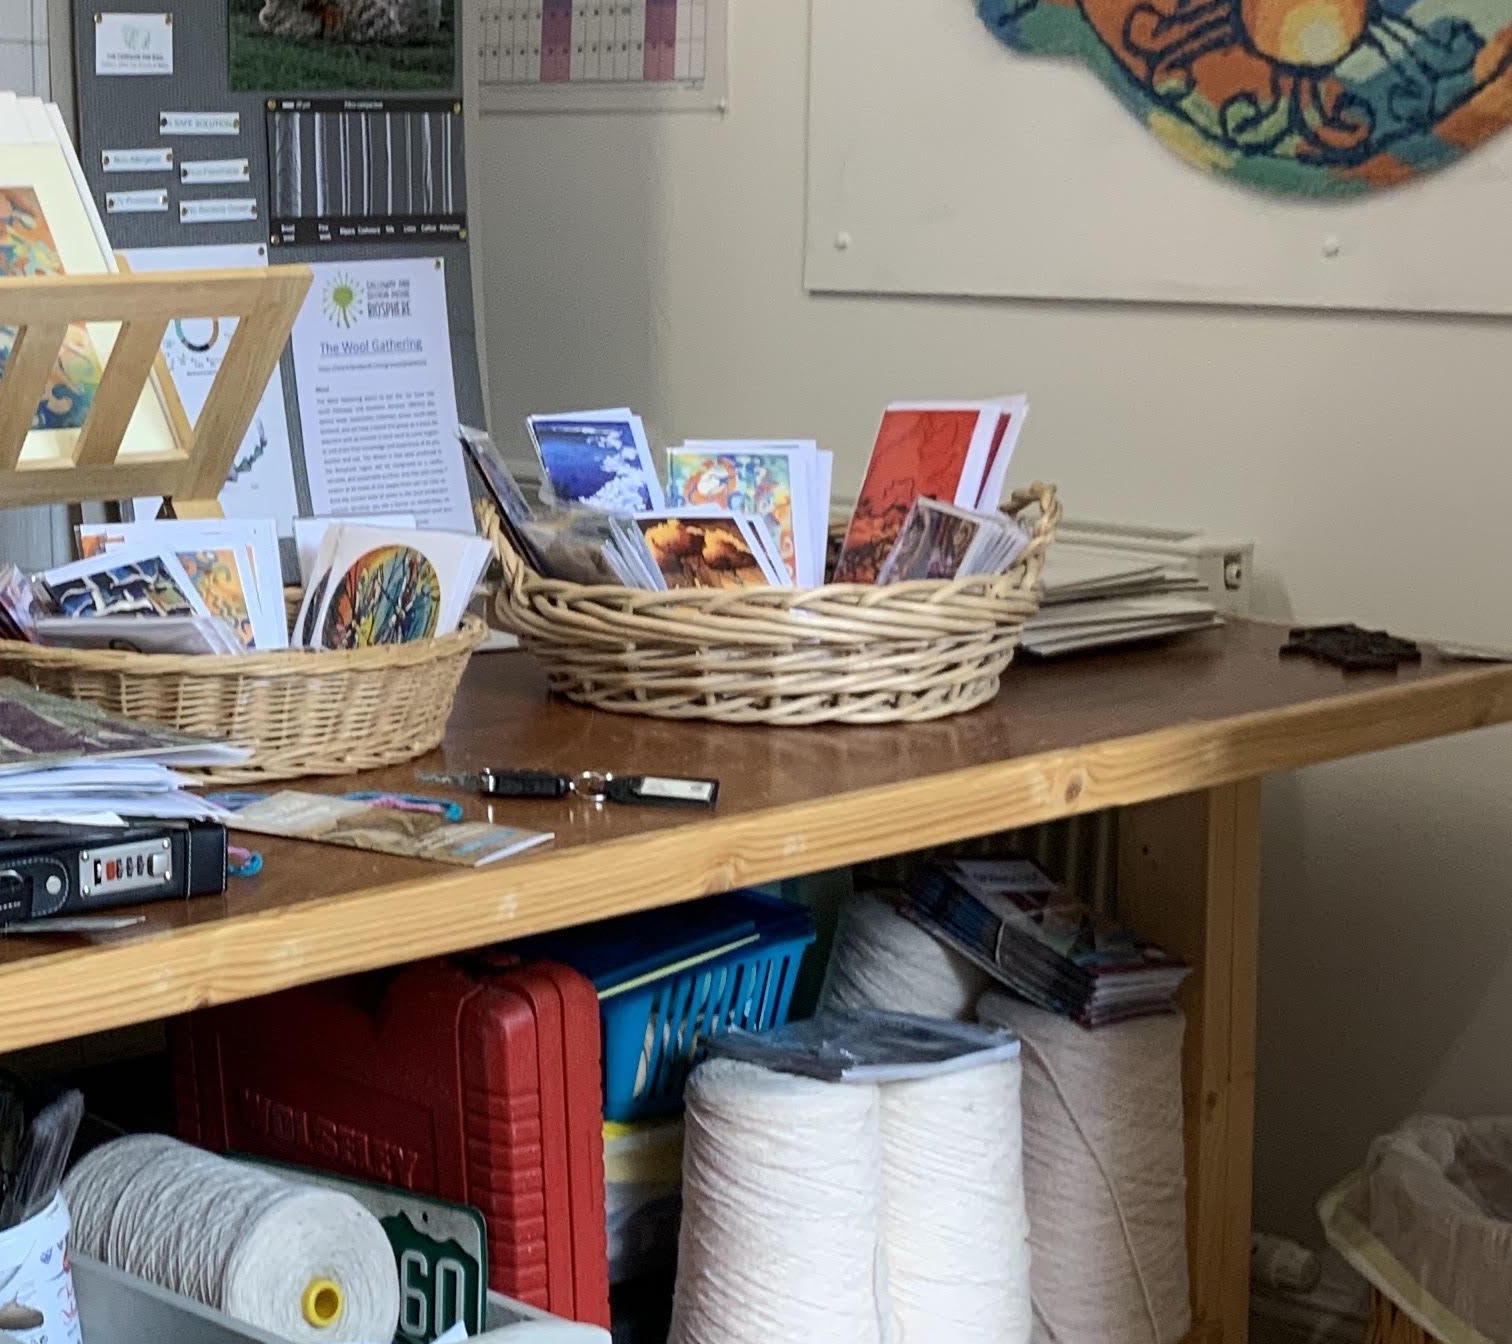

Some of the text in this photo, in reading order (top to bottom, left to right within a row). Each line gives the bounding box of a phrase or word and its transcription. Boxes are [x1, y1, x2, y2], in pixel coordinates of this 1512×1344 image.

[320, 337, 423, 355] The Wool Gathering
[399, 1248, 466, 1339] 60
